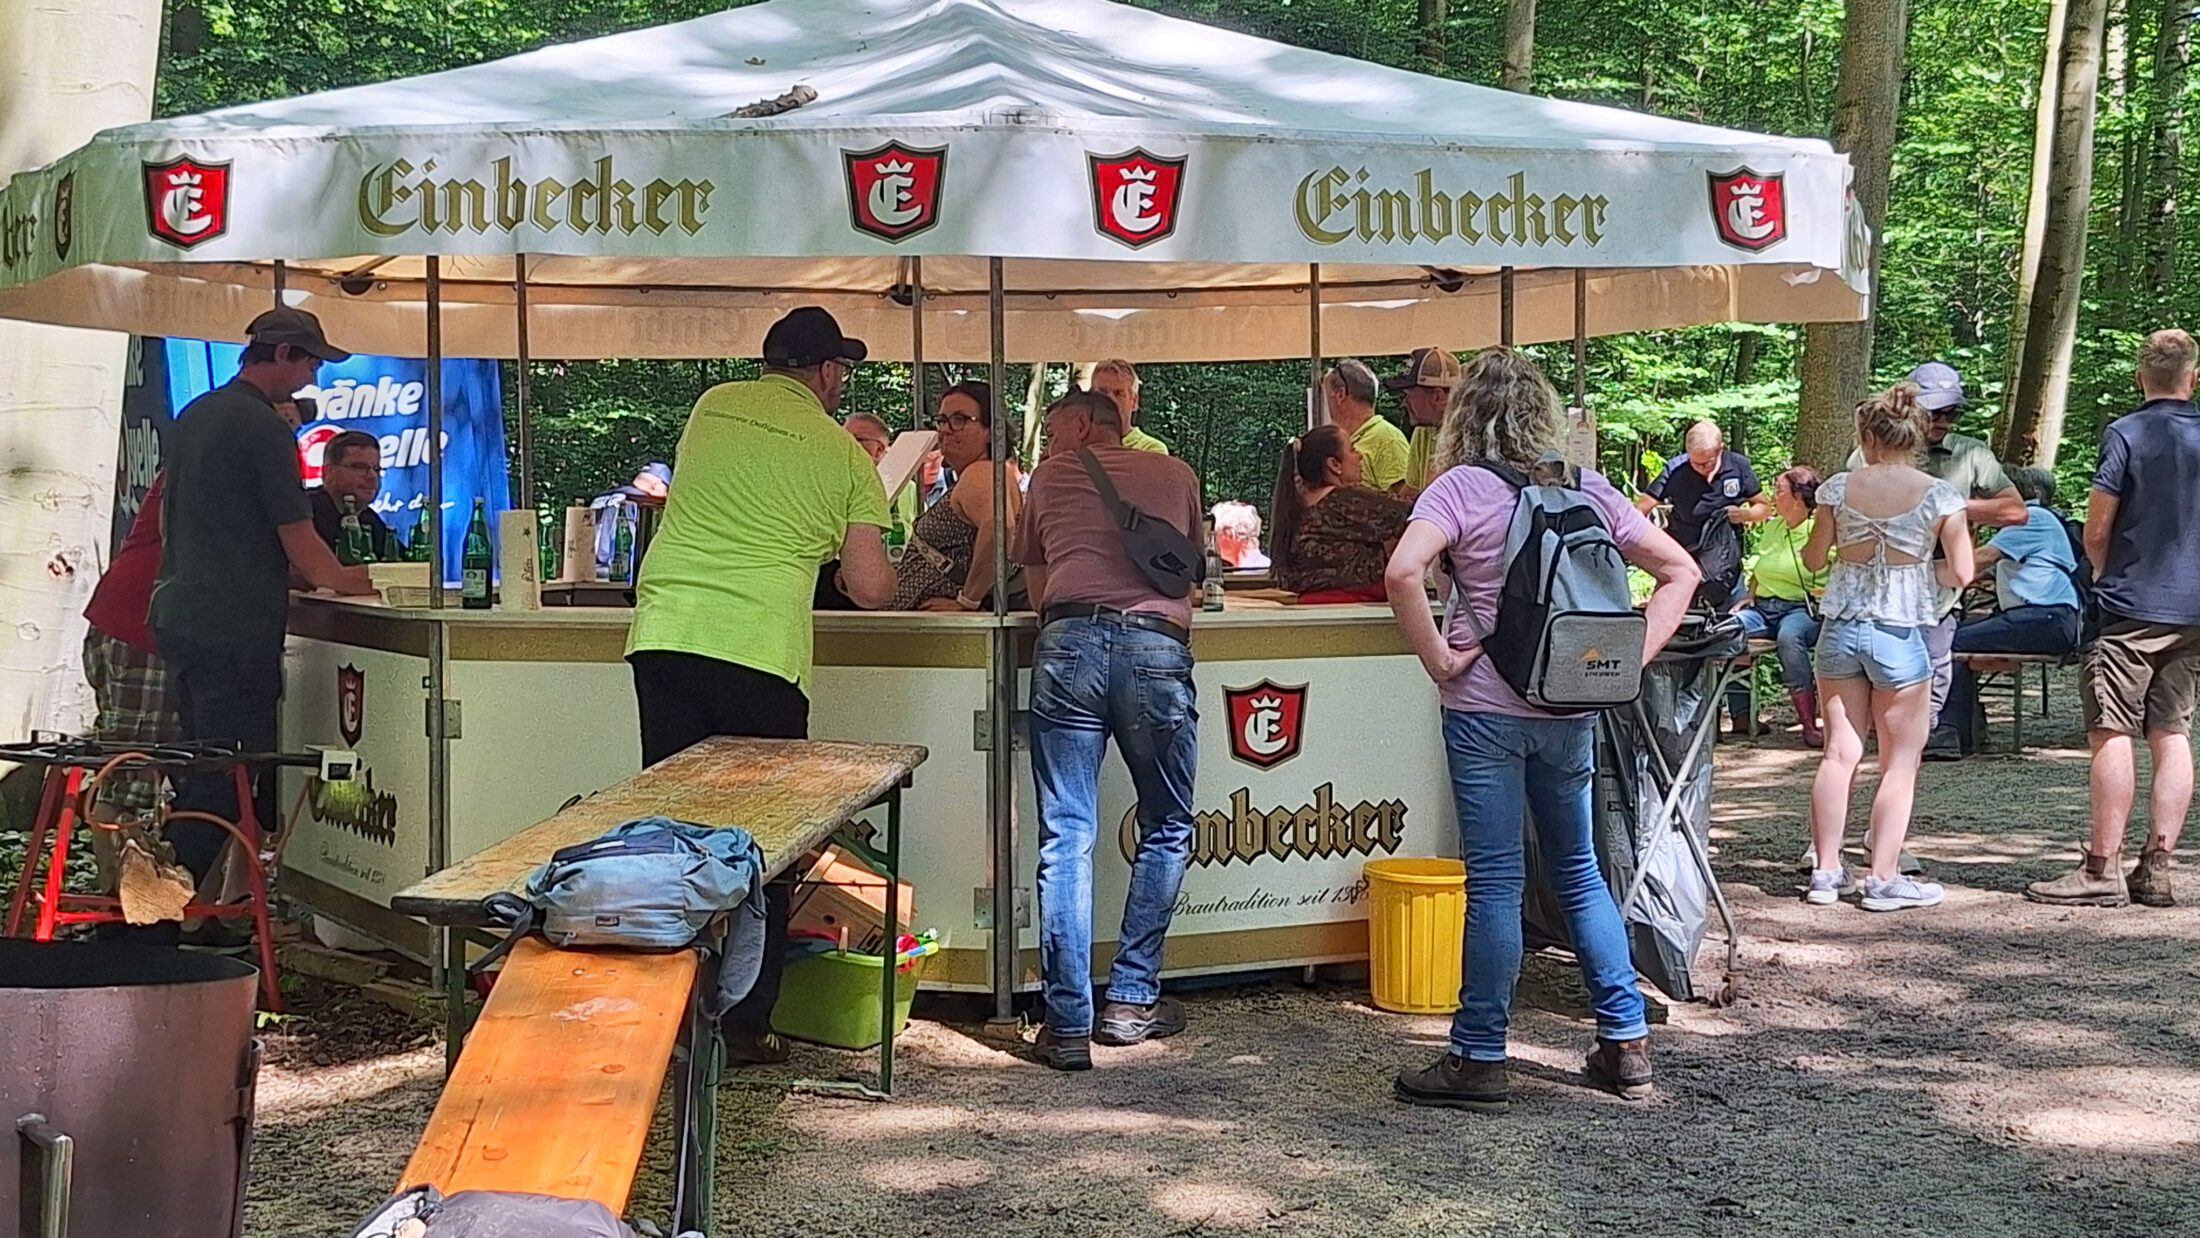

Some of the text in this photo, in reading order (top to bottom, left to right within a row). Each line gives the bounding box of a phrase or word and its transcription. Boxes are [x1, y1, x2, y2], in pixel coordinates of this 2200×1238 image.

[358, 154, 715, 238] Einbecker
[1293, 165, 1610, 248] Einbecker
[1586, 659, 1621, 670] SMT
[1173, 887, 1292, 917] Brautradition
[1297, 887, 1331, 907] seit
